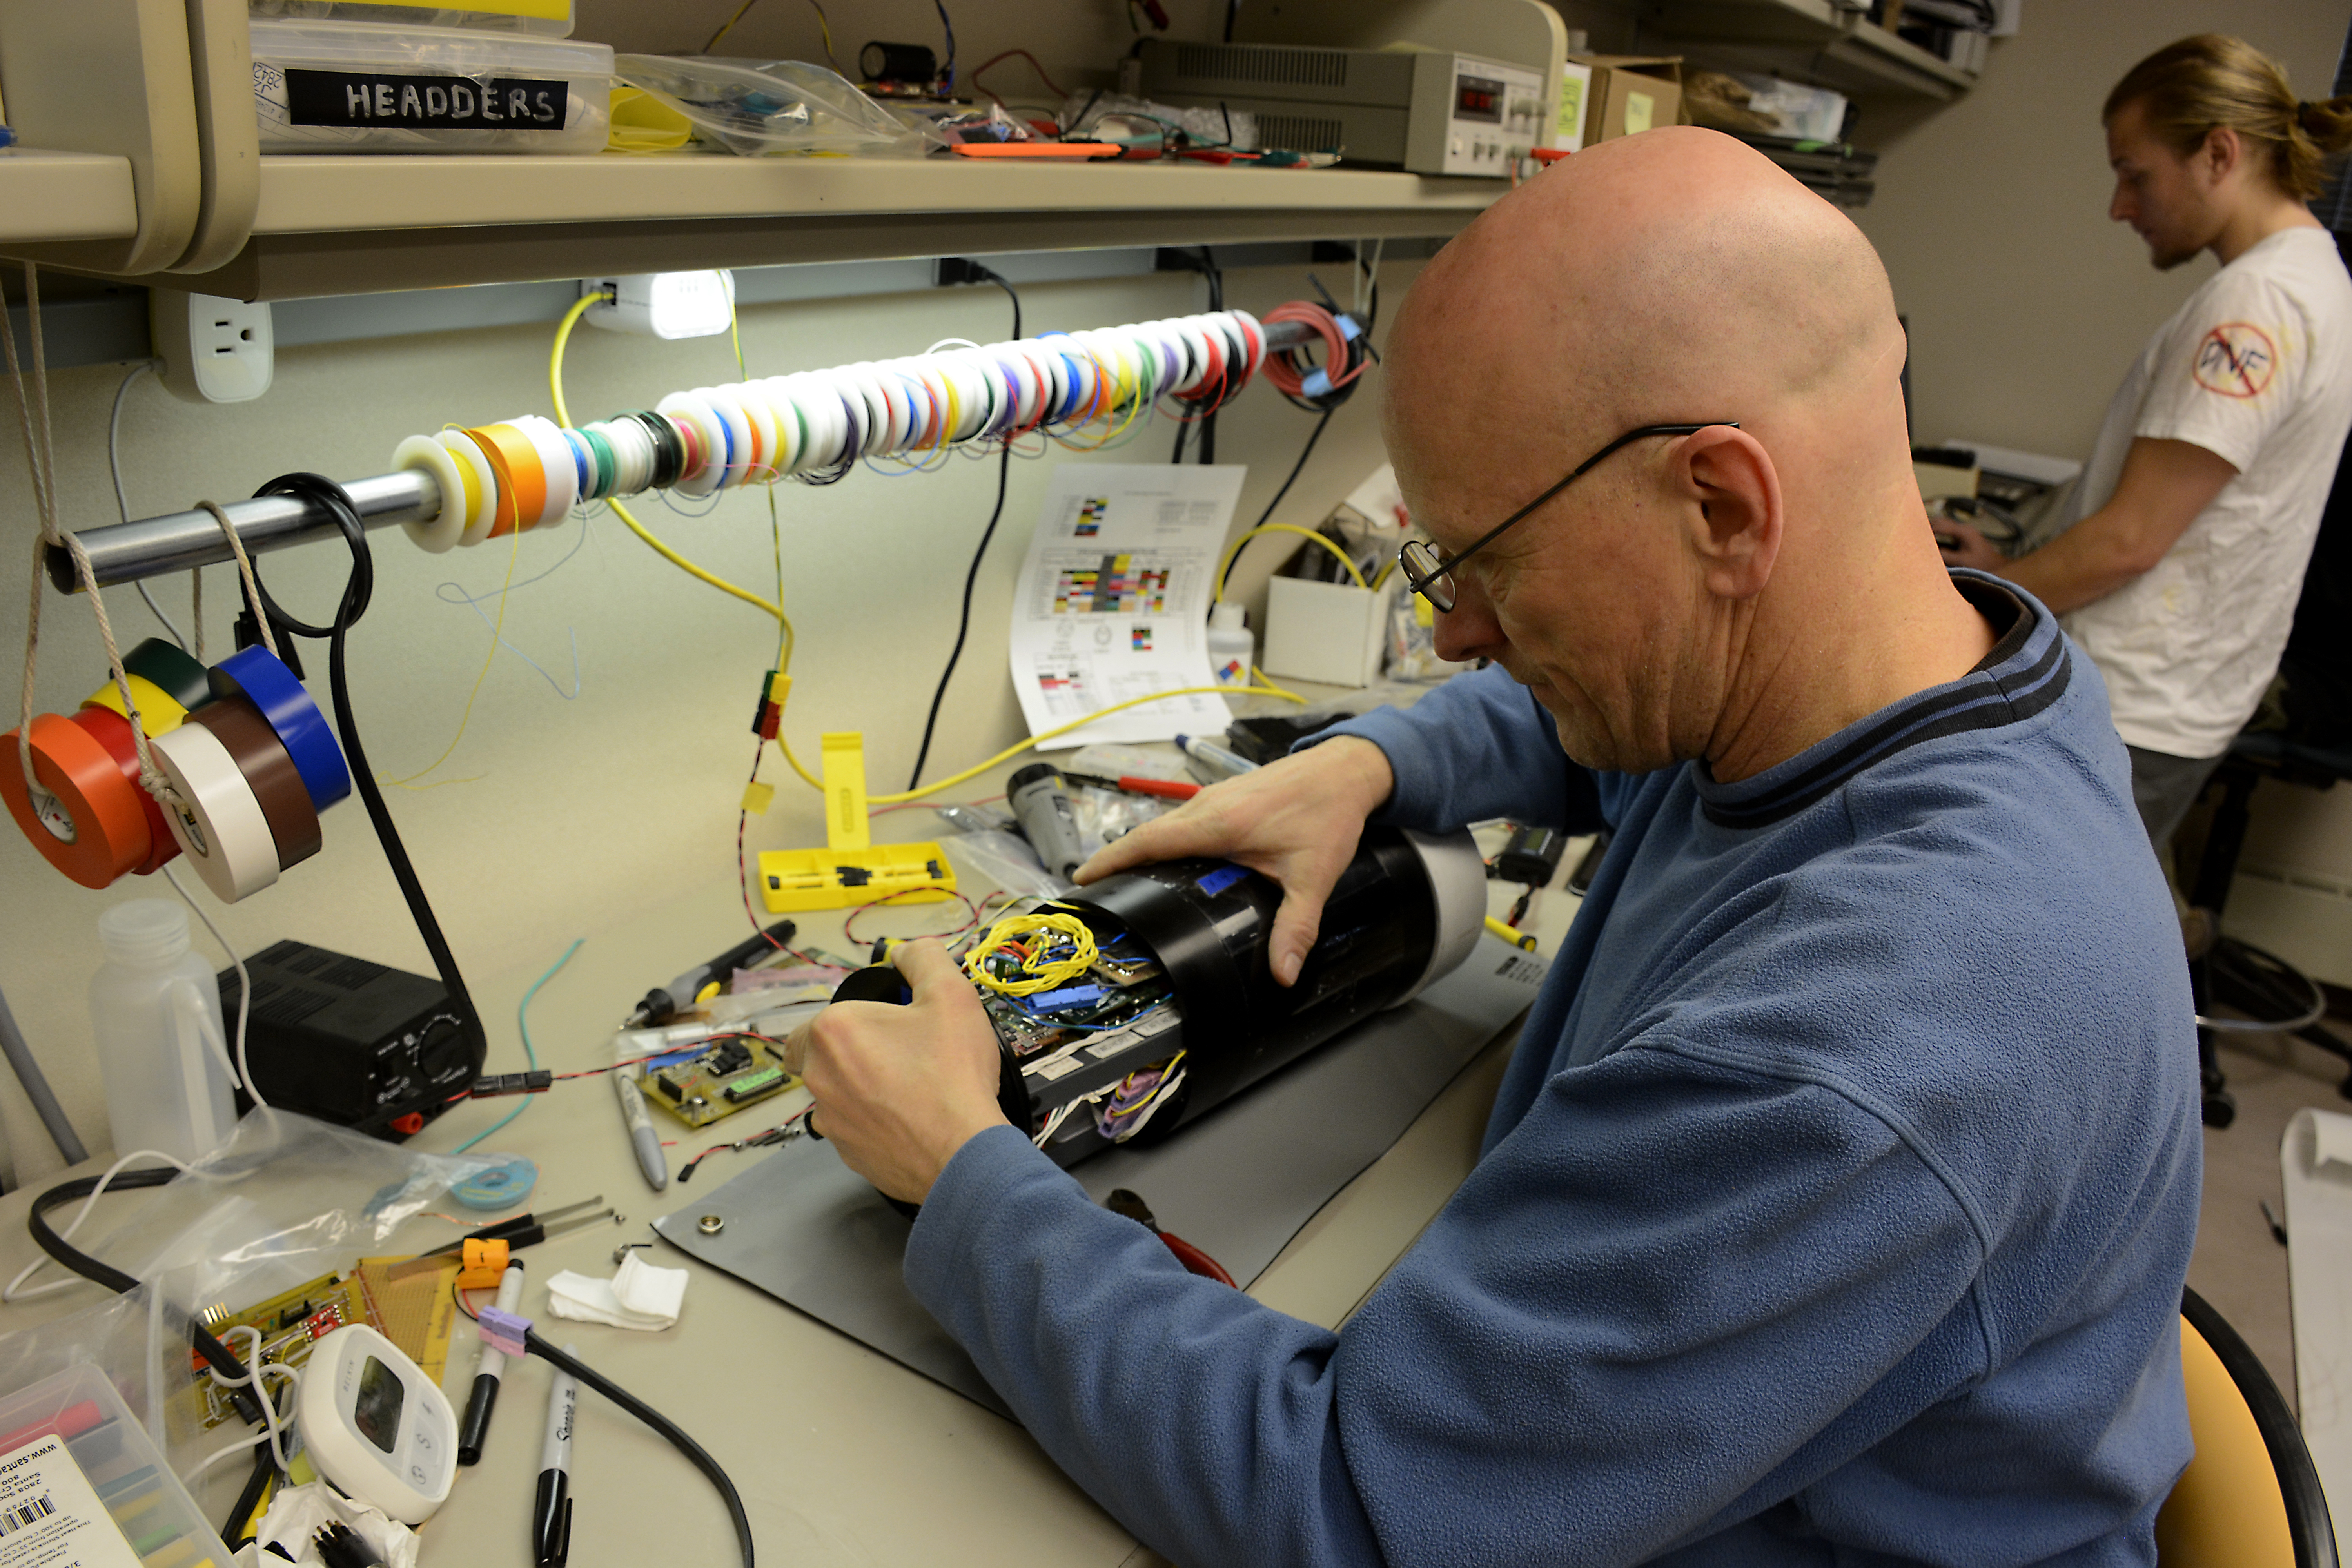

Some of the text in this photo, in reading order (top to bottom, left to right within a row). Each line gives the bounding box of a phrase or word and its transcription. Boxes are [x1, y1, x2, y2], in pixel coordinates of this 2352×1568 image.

[347, 84, 555, 122] HEADDERS
[343, 1359, 354, 1392] BELKIN
[15, 1472, 41, 1486] Santa
[18, 1479, 42, 1493] 2808
[46, 1519, 78, 1537] operation
[77, 1520, 91, 1528] This
[60, 1527, 77, 1537] Heat
[4, 1540, 22, 1550] short
[29, 1535, 45, 1545] from
[38, 1535, 60, 1548] Shrink
[12, 1550, 30, 1561] rated
[36, 1548, 56, 1559] Temp.
[40, 1550, 67, 1565] Flexible
